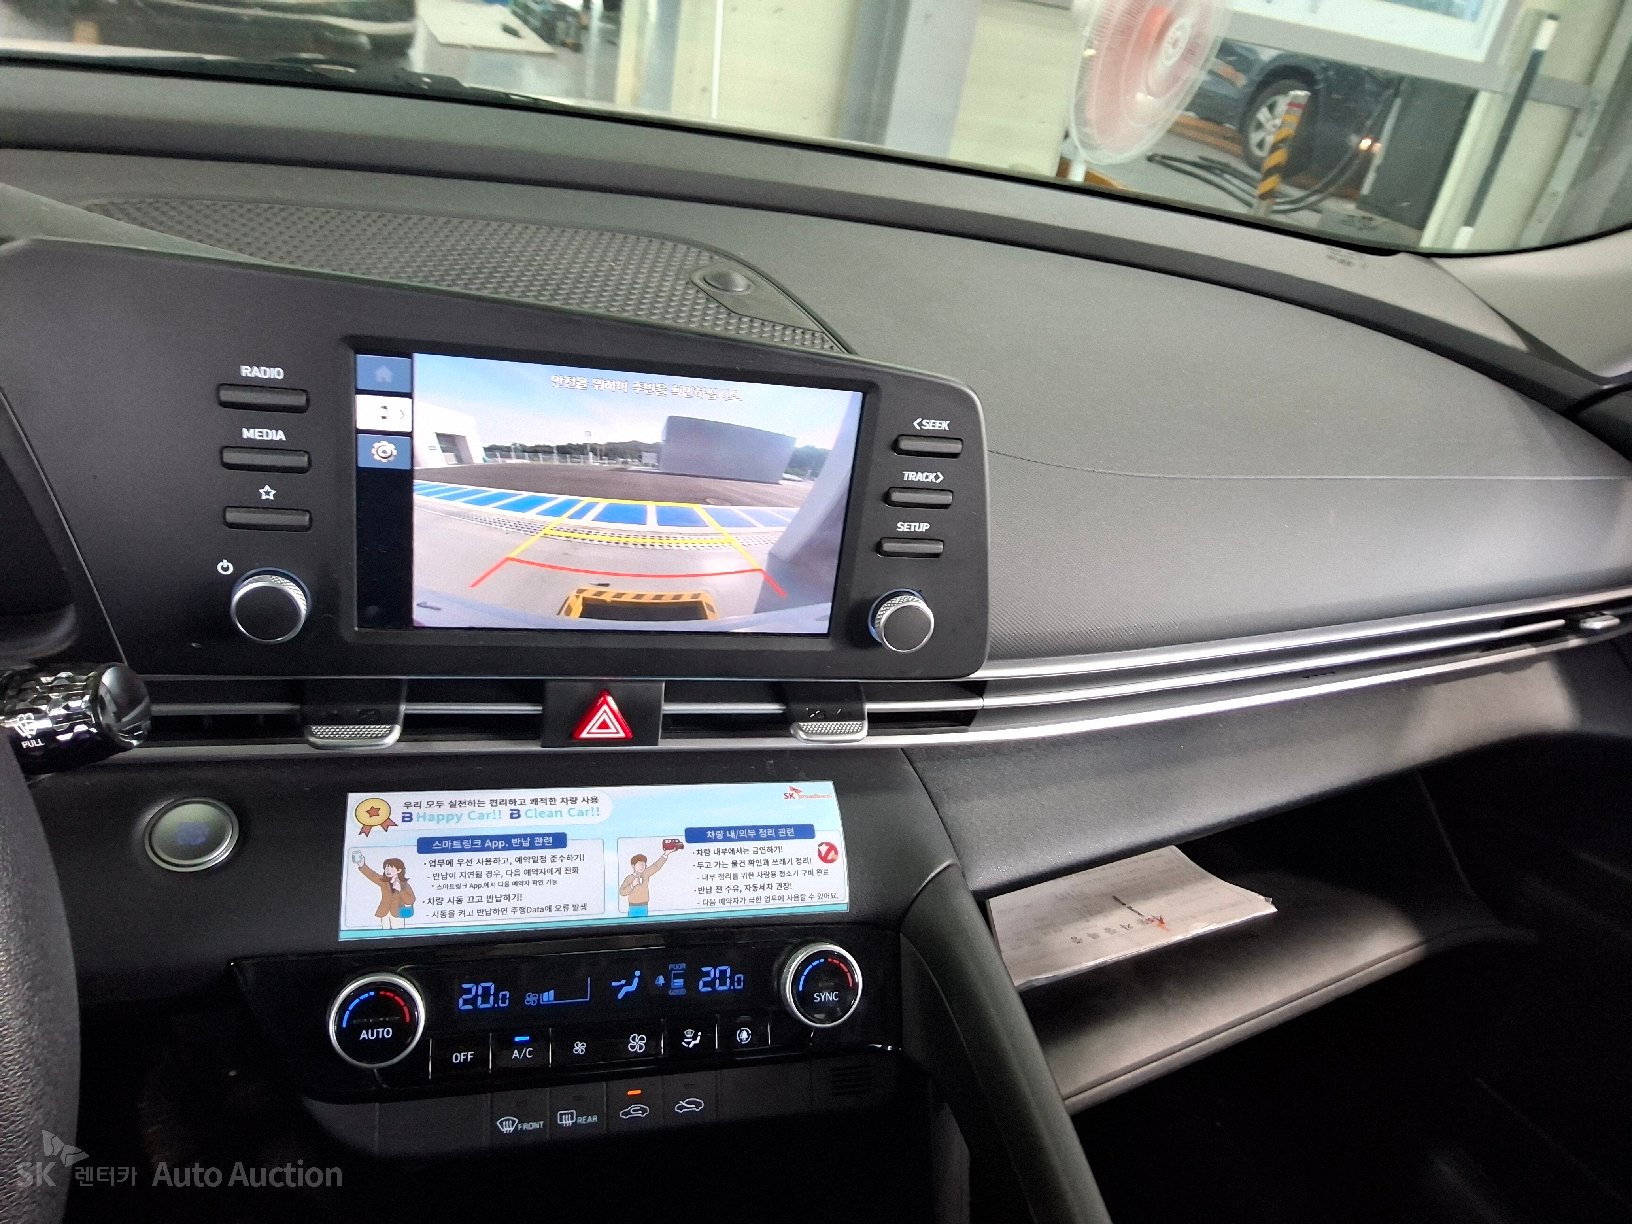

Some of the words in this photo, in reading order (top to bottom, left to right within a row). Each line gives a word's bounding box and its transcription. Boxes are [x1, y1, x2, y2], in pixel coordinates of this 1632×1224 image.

[240, 365, 284, 379] RADIO
[921, 419, 950, 430] SEEK
[241, 428, 286, 441] MEDIA
[902, 471, 936, 482] TRACK
[896, 521, 930, 532] SETUP
[21, 740, 45, 749] PULL
[783, 792, 795, 800] SK
[403, 801, 422, 809] 우리
[425, 800, 444, 809] 모두
[448, 799, 486, 808] 실천하는
[489, 798, 527, 807] 편리하고
[530, 797, 557, 806] 쾌적한
[560, 796, 578, 805] 차량
[581, 796, 599, 804] 사용
[417, 812, 463, 824] Happy
[468, 809, 501, 821] Car!!
[525, 808, 563, 819] Clean
[568, 806, 600, 817] Car!!
[706, 830, 724, 840] 차량
[759, 828, 776, 838] 정리
[778, 827, 795, 837] 관련
[432, 840, 482, 849] 스마트링크
[484, 839, 508, 849] App.
[511, 837, 531, 847] 반납
[534, 836, 553, 846] 관련
[696, 848, 711, 857] 차량
[714, 847, 750, 855] 내부에서는
[753, 845, 784, 854] 금연하기!
[429, 859, 454, 868] 업무에
[457, 858, 473, 867] 우선
[476, 857, 513, 866] 사용하고,
[515, 855, 547, 864] 예약일정
[550, 854, 585, 863] 준수하기!
[697, 861, 712, 869] 두고
[714, 861, 728, 869] 가는
[772, 858, 793, 866] 쓰레기
[795, 857, 812, 865] 정리!
[433, 872, 456, 880] 반납이
[459, 870, 482, 879] 지연될
[486, 869, 504, 879] 경우,
[506, 868, 520, 877] 다음
[698, 886, 712, 894] 반납
[715, 885, 723, 894] 전
[745, 883, 773, 892] 자동세차
[426, 897, 444, 905] 차량
[447, 896, 463, 905] 시동
[486, 893, 523, 903] 반납하기!
[431, 910, 455, 919] 시동을
[477, 907, 508, 917] 반납하면
[555, 904, 569, 912] 오류
[699, 966, 744, 992] 20.0
[459, 982, 509, 1010] 20.0
[813, 991, 839, 1003] SYNC
[359, 1027, 393, 1041] AUTO
[452, 1052, 475, 1063] OFF
[511, 1047, 534, 1060] A/C
[517, 1120, 545, 1131] FRONT
[577, 1114, 598, 1125] REAR
